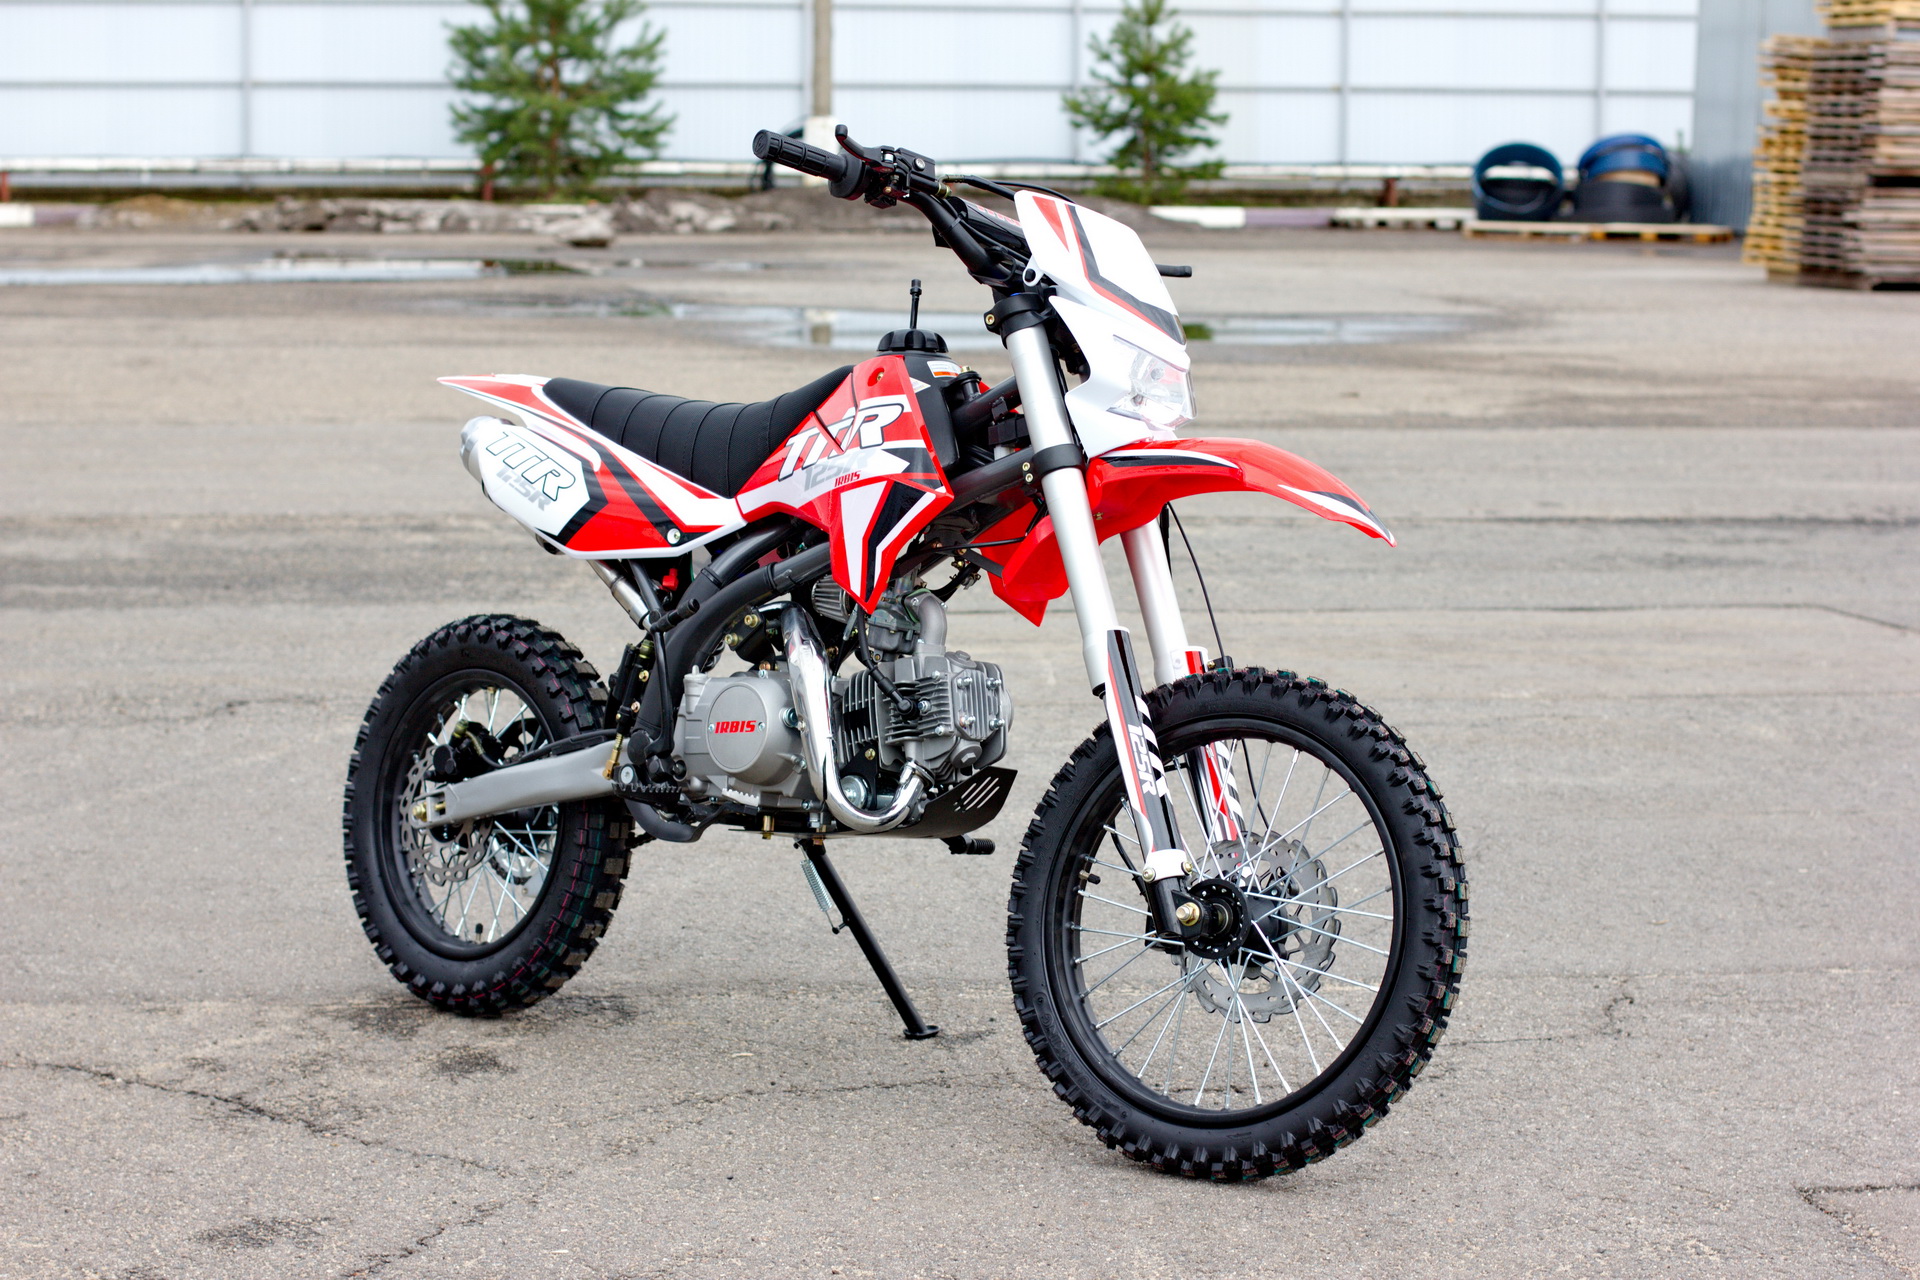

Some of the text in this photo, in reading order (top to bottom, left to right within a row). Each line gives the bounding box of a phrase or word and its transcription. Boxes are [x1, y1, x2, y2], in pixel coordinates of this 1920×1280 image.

[485, 430, 576, 502] TTR
[778, 402, 904, 482] TTR
[834, 470, 861, 487] IRBIS
[714, 719, 757, 734] IRBIS
[1127, 723, 1158, 796] 125R
